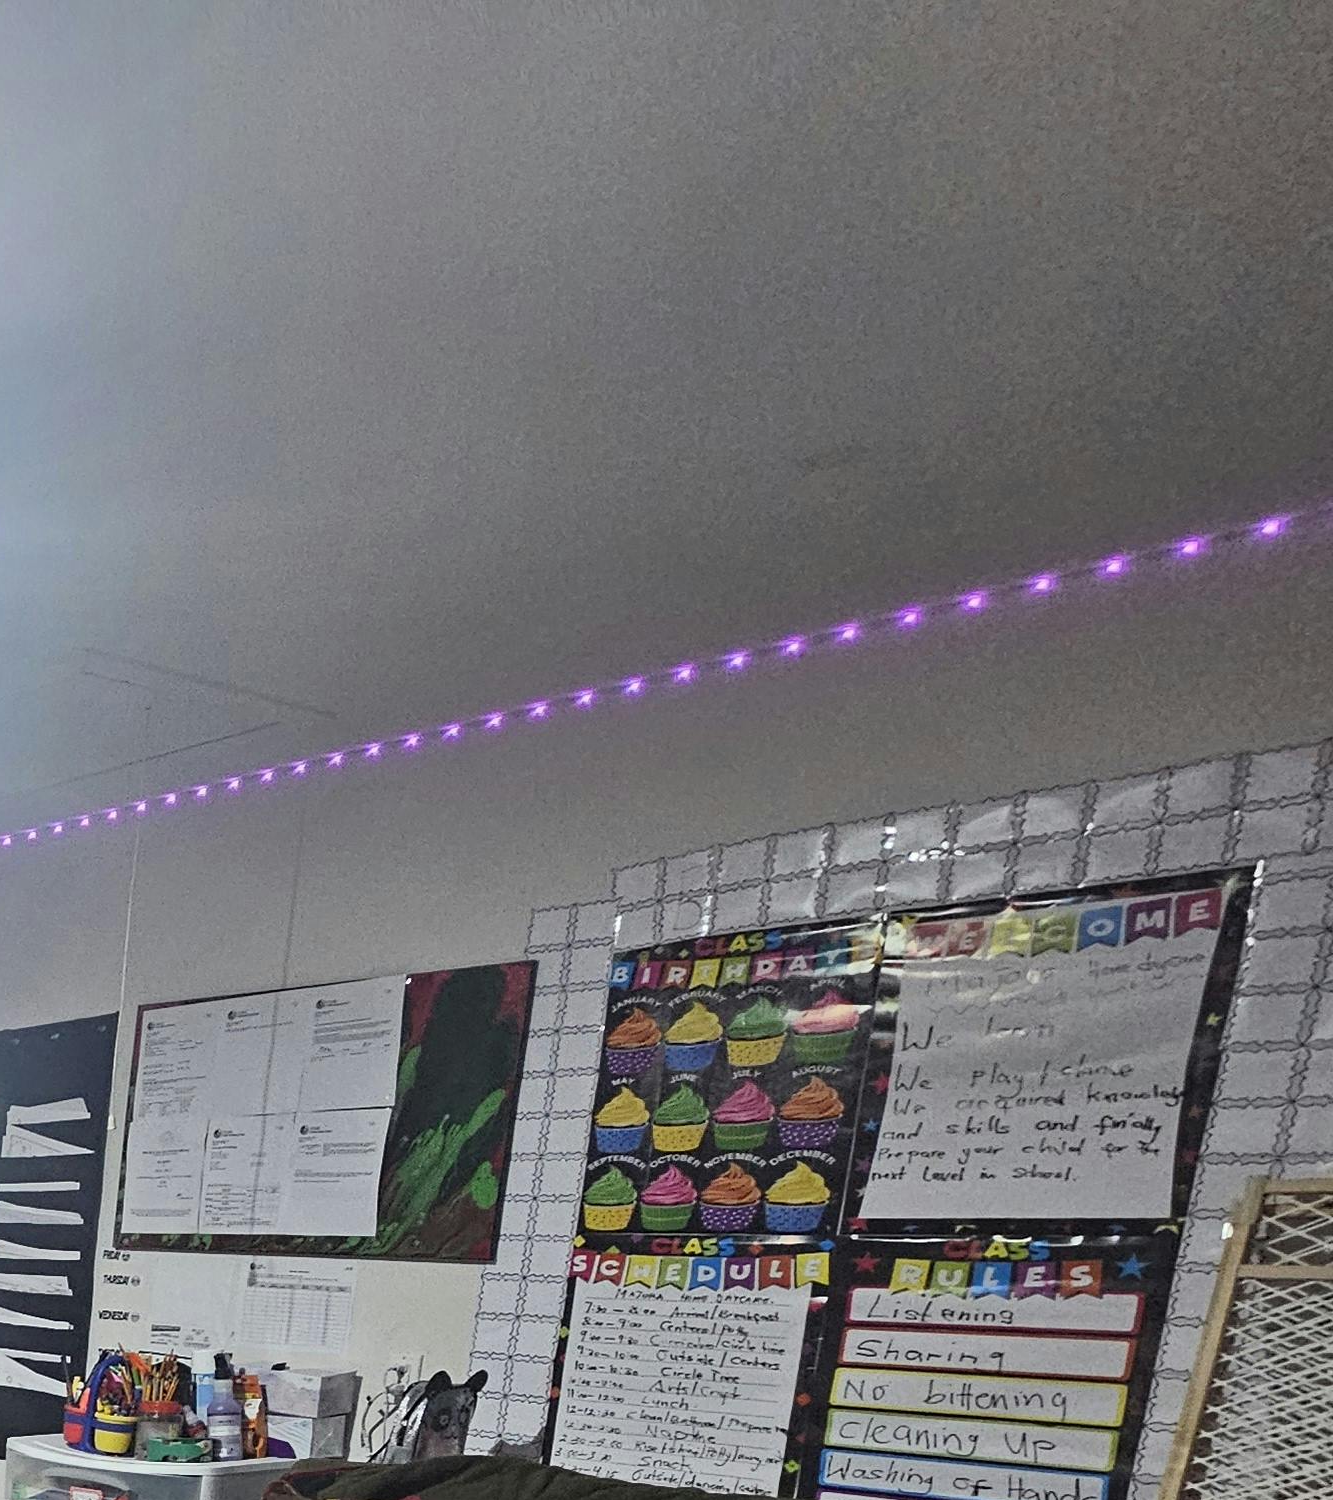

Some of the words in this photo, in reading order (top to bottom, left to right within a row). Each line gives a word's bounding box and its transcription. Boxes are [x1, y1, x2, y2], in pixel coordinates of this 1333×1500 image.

[694, 930, 782, 953] CLASS
[611, 949, 872, 983] BIRTHDAY
[735, 986, 783, 999] MARCH
[809, 978, 846, 991] APRIL
[611, 996, 662, 1013] JANUARY
[669, 991, 727, 1007] FEBRUARY
[901, 1021, 953, 1051] We
[669, 1074, 699, 1084] JUNE
[792, 1066, 843, 1078] AUGUST
[894, 1064, 934, 1092] We
[883, 1123, 922, 1140] and
[946, 1116, 1010, 1135] skills
[1035, 1115, 1079, 1134] and
[1021, 1138, 1086, 1156] child
[587, 1154, 647, 1171] SEPTEMBER
[649, 1153, 701, 1169] OCTOBER
[704, 1152, 767, 1169] NOVEMBER
[769, 1150, 837, 1166] DECEMBER
[651, 1238, 736, 1256] CLASS
[943, 1240, 1050, 1260] CLASS
[572, 1254, 823, 1283] SCHEDULE
[899, 1265, 1094, 1290] RULES
[867, 1294, 1014, 1325] Listening
[856, 1339, 1005, 1371] Sharing
[844, 1379, 888, 1401] No
[825, 1455, 933, 1494] Washing
[953, 1477, 992, 1496] of
